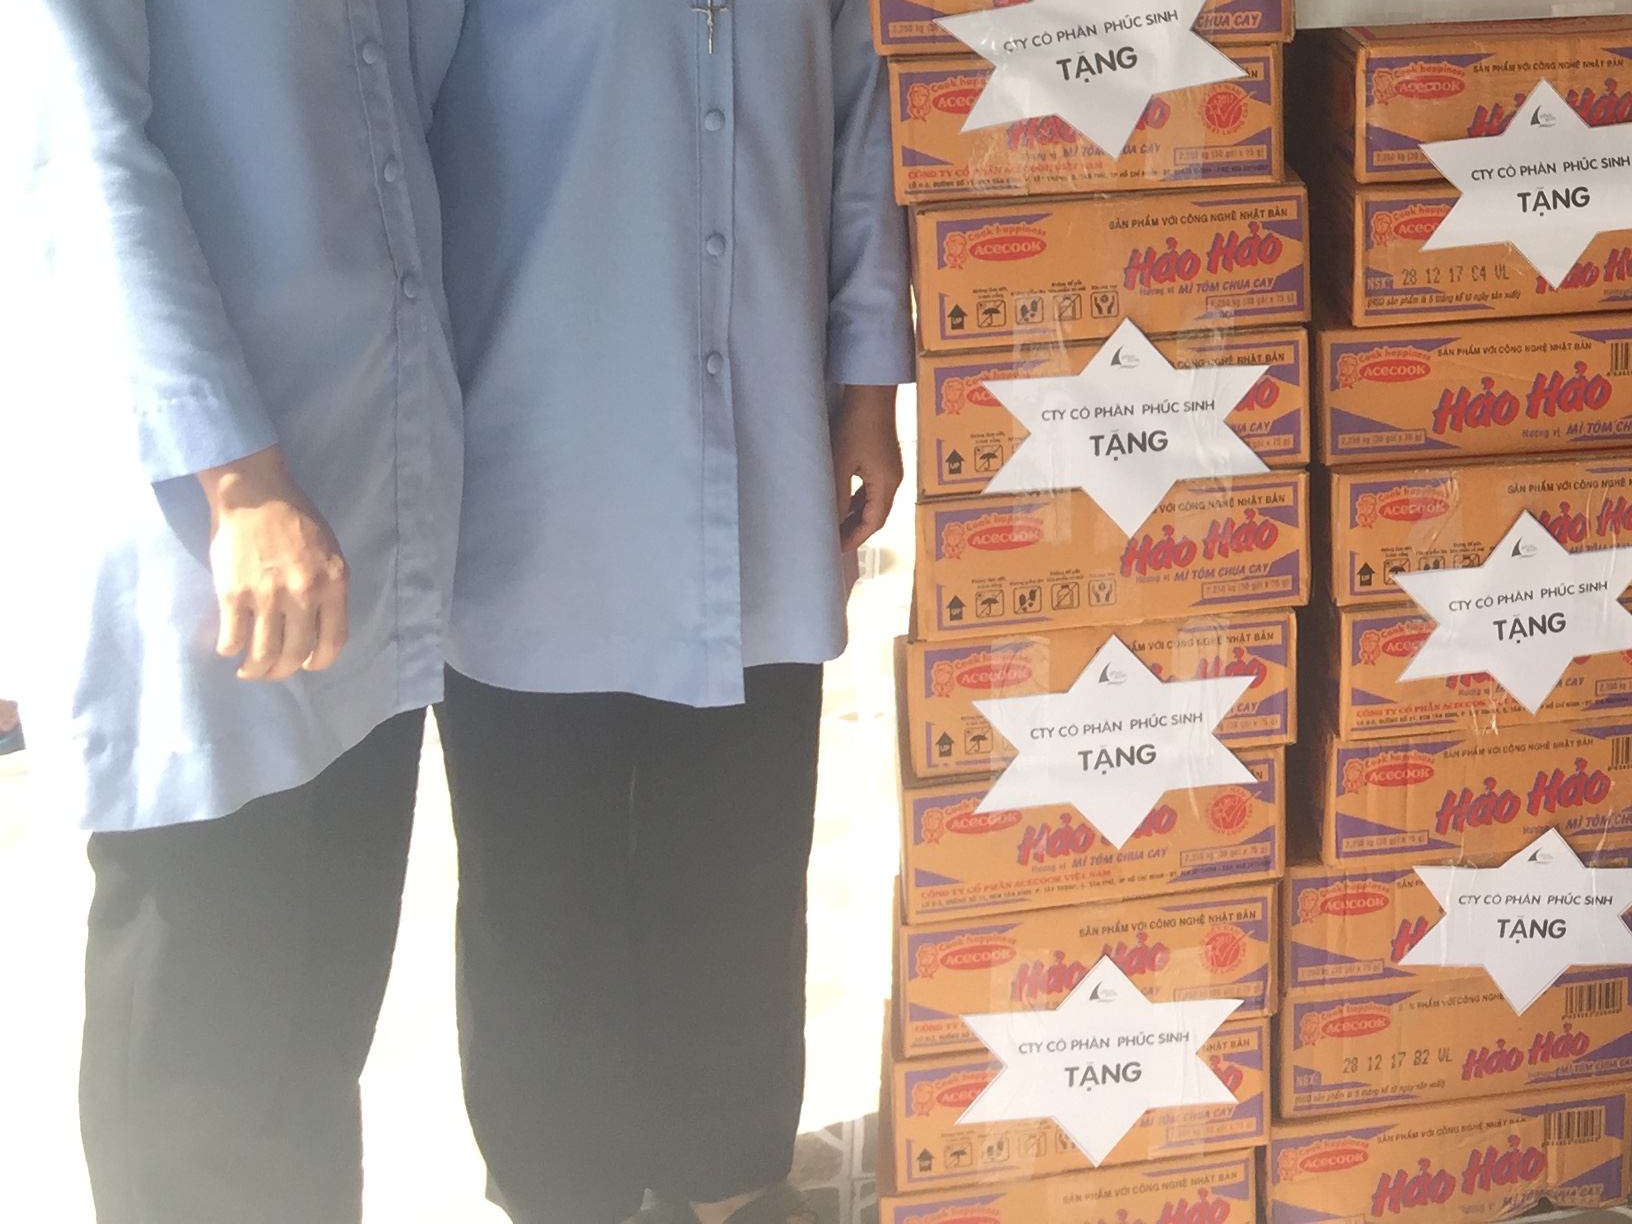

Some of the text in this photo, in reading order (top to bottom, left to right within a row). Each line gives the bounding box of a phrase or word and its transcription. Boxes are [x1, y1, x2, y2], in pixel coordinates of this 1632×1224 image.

[1004, 37, 1029, 53] CTY
[1104, 14, 1143, 33] PHÚC
[1146, 10, 1179, 26] SINH
[1057, 46, 1138, 83] TẶNG
[1471, 167, 1494, 181] CTY
[1563, 157, 1598, 171] PHÚC
[1601, 155, 1630, 169] SINH
[1517, 186, 1590, 216] TẶNG
[1124, 222, 1283, 290] Hảo Hảo
[1042, 407, 1067, 421] CTY
[1142, 398, 1180, 414] PHÚC
[1184, 400, 1215, 413] SINH
[1432, 362, 1612, 434] Hảo Hảo
[1090, 429, 1168, 461] TẶNG
[1121, 509, 1279, 575] Hảo Hảo
[1449, 598, 1472, 612] CTY
[1541, 583, 1575, 600] PHÚC
[1578, 581, 1607, 595] SINH
[1493, 612, 1566, 644] TẶNG
[1030, 726, 1055, 740] CTY
[1130, 713, 1168, 729] PHÚC
[1172, 712, 1203, 725] SINH
[1078, 744, 1156, 774] TẶNG
[1436, 758, 1611, 834] Hảo Hảo
[1018, 813, 1095, 866] Hảo
[1459, 894, 1481, 906] CTY
[1548, 892, 1582, 906] PHÚC
[1584, 894, 1613, 906] SINH
[1498, 916, 1566, 944] TẶNG
[1018, 1040, 1044, 1055] CTY
[1118, 1031, 1155, 1047] PHÚC
[1158, 1031, 1189, 1044] SINH
[1462, 1023, 1590, 1080] Hảo Hảo
[1065, 1061, 1142, 1091] TẶNG
[1343, 1058, 1359, 1074] 28
[1368, 1056, 1382, 1072] 12
[1372, 1136, 1546, 1217] Hảo Hảo
